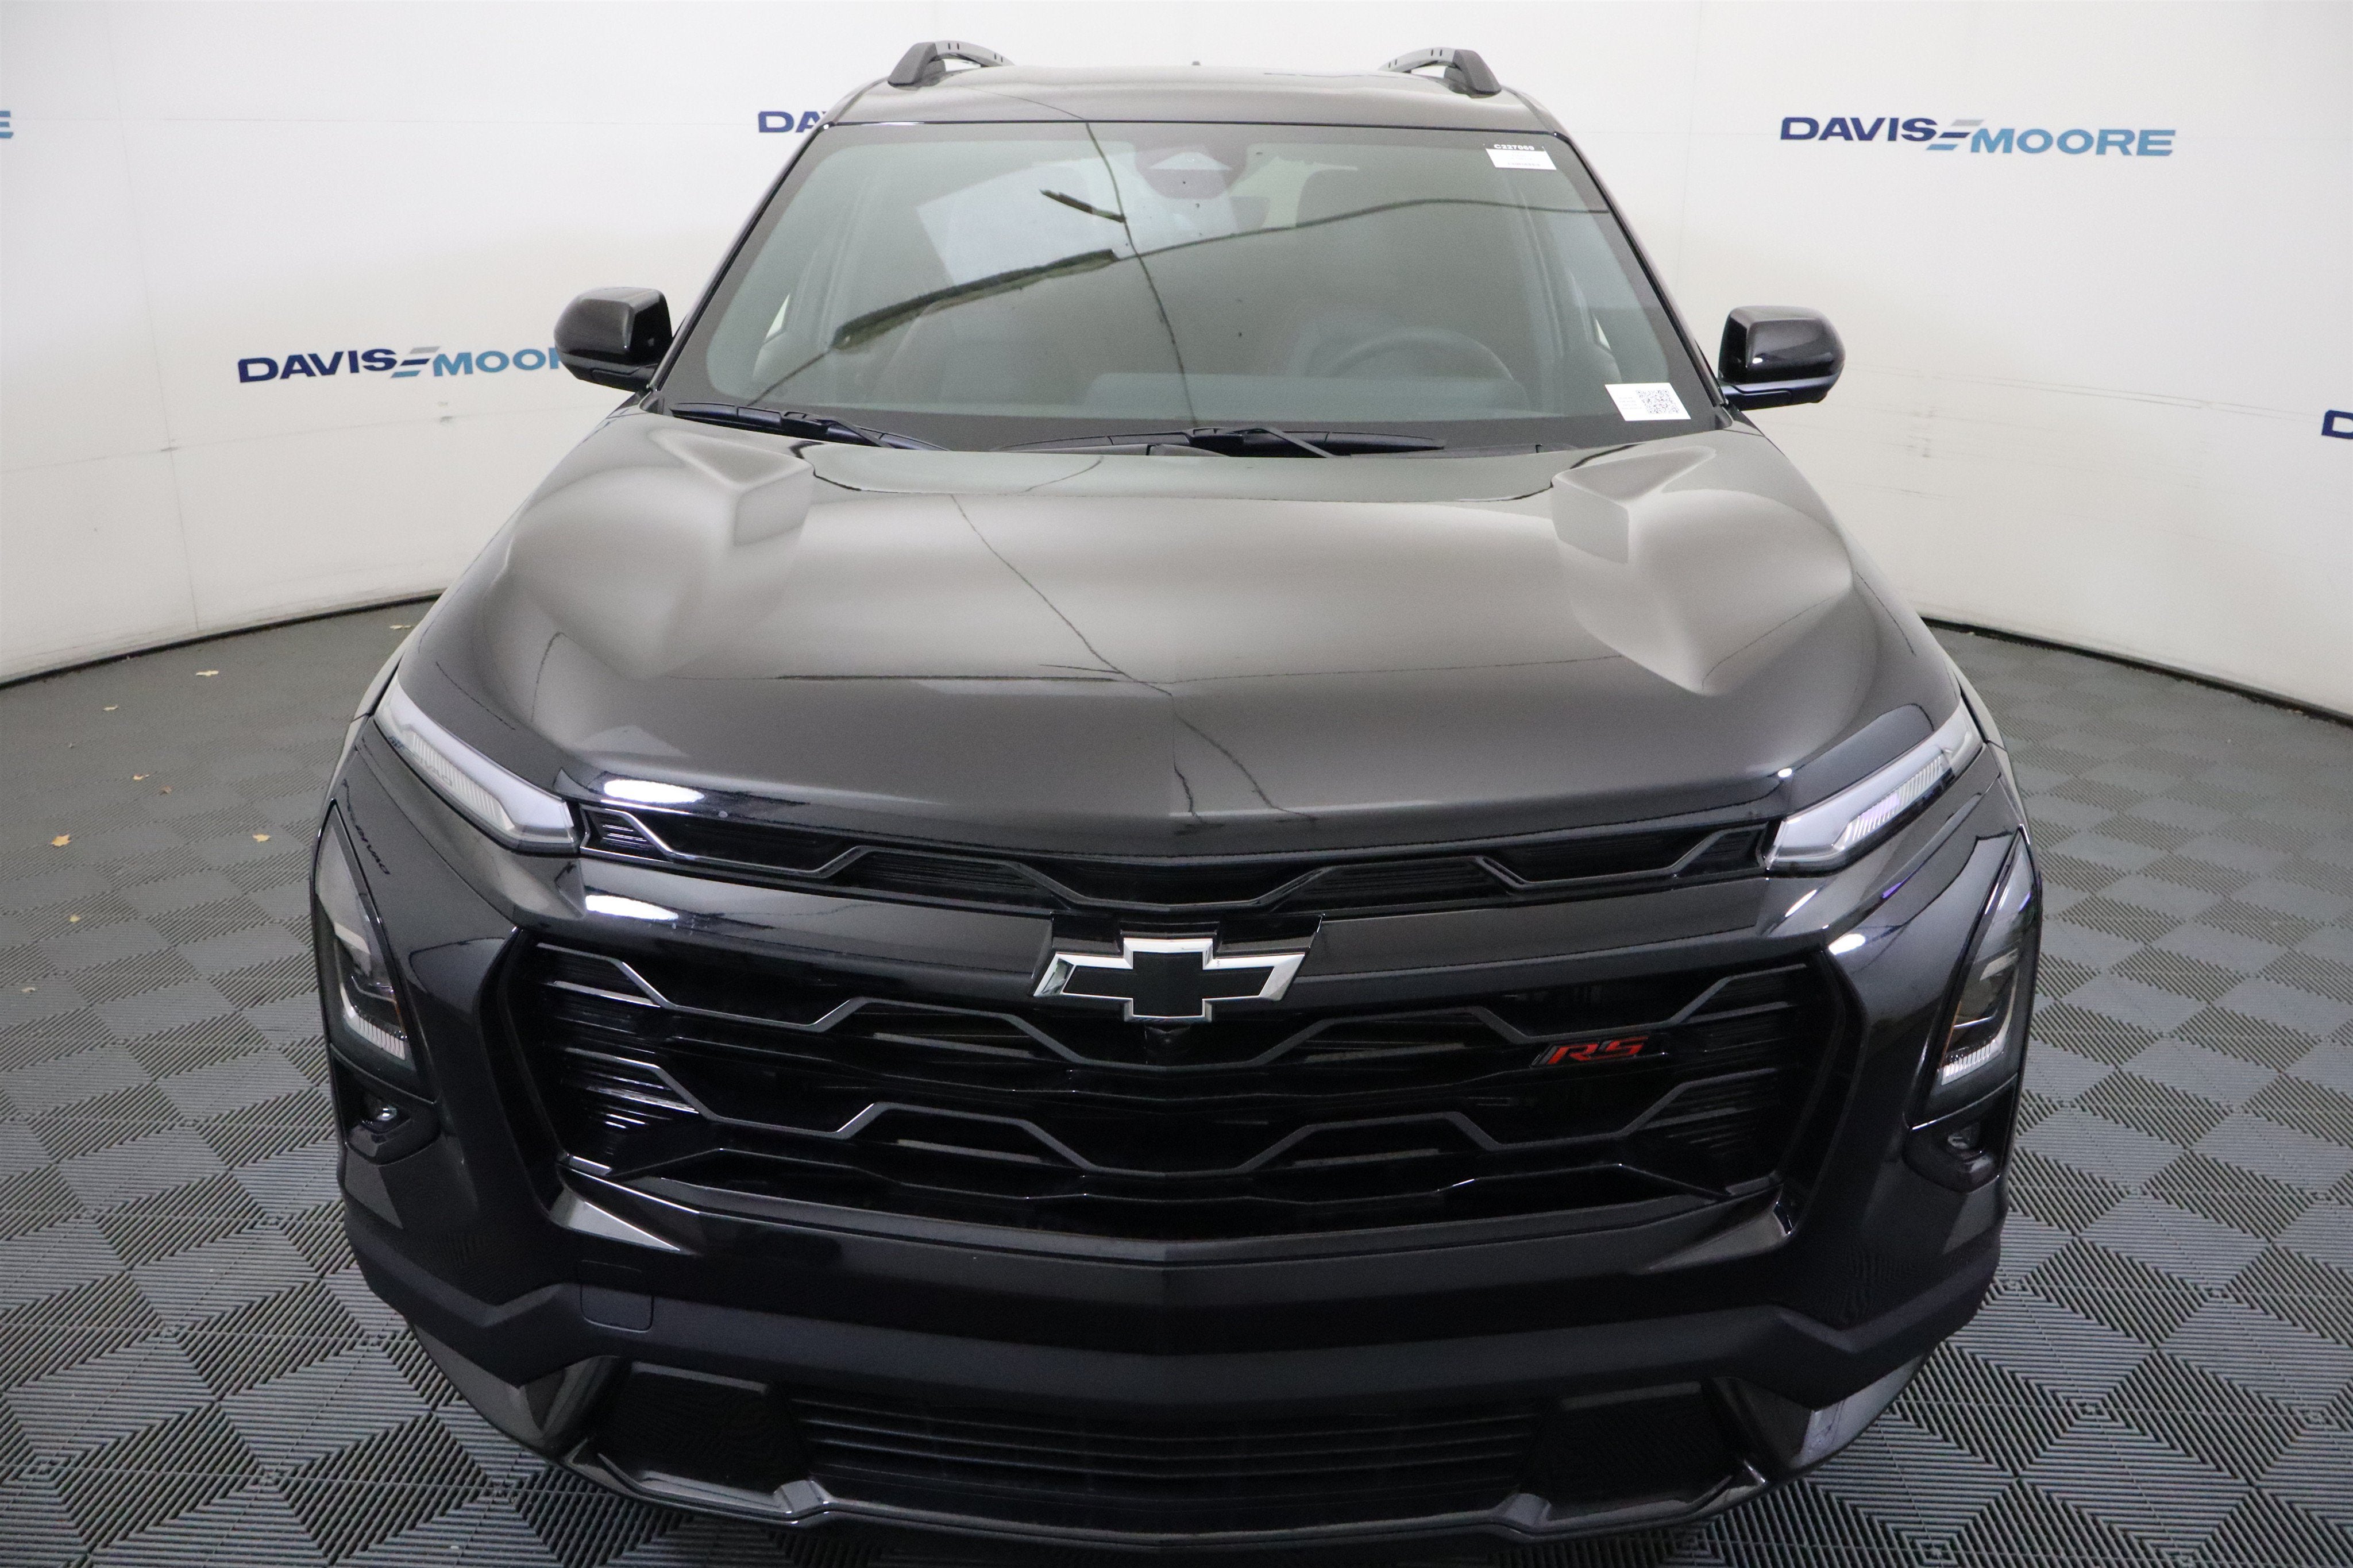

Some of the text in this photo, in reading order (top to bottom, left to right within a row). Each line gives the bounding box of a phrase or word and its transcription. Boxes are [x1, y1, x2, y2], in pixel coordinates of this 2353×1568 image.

[758, 111, 826, 133] DA
[1780, 117, 2176, 157] DAVIS MOORE
[237, 347, 398, 383] DAVIS
[1541, 1036, 1649, 1065] RS
